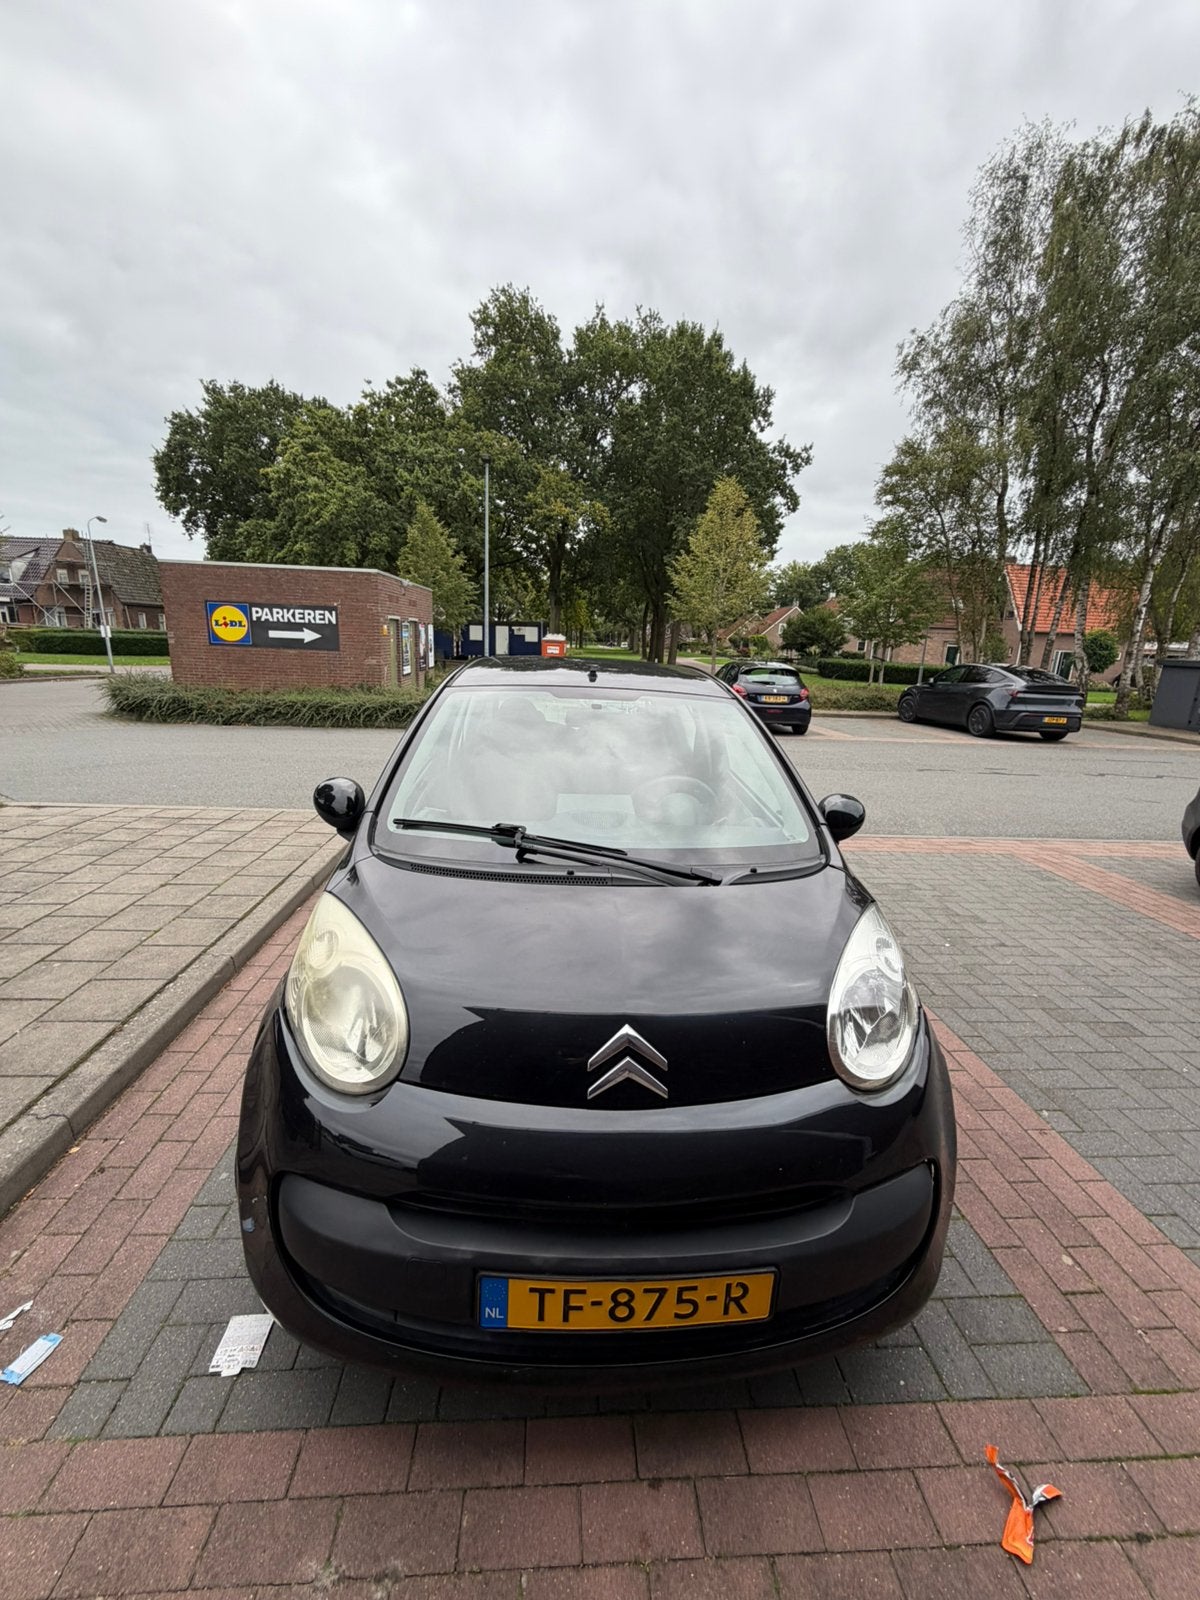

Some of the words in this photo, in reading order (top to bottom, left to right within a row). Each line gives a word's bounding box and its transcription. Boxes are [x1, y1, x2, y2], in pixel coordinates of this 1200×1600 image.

[251, 607, 337, 625] PARKEREN
[528, 1281, 750, 1323] TF-875-R
[485, 1307, 504, 1319] NL
